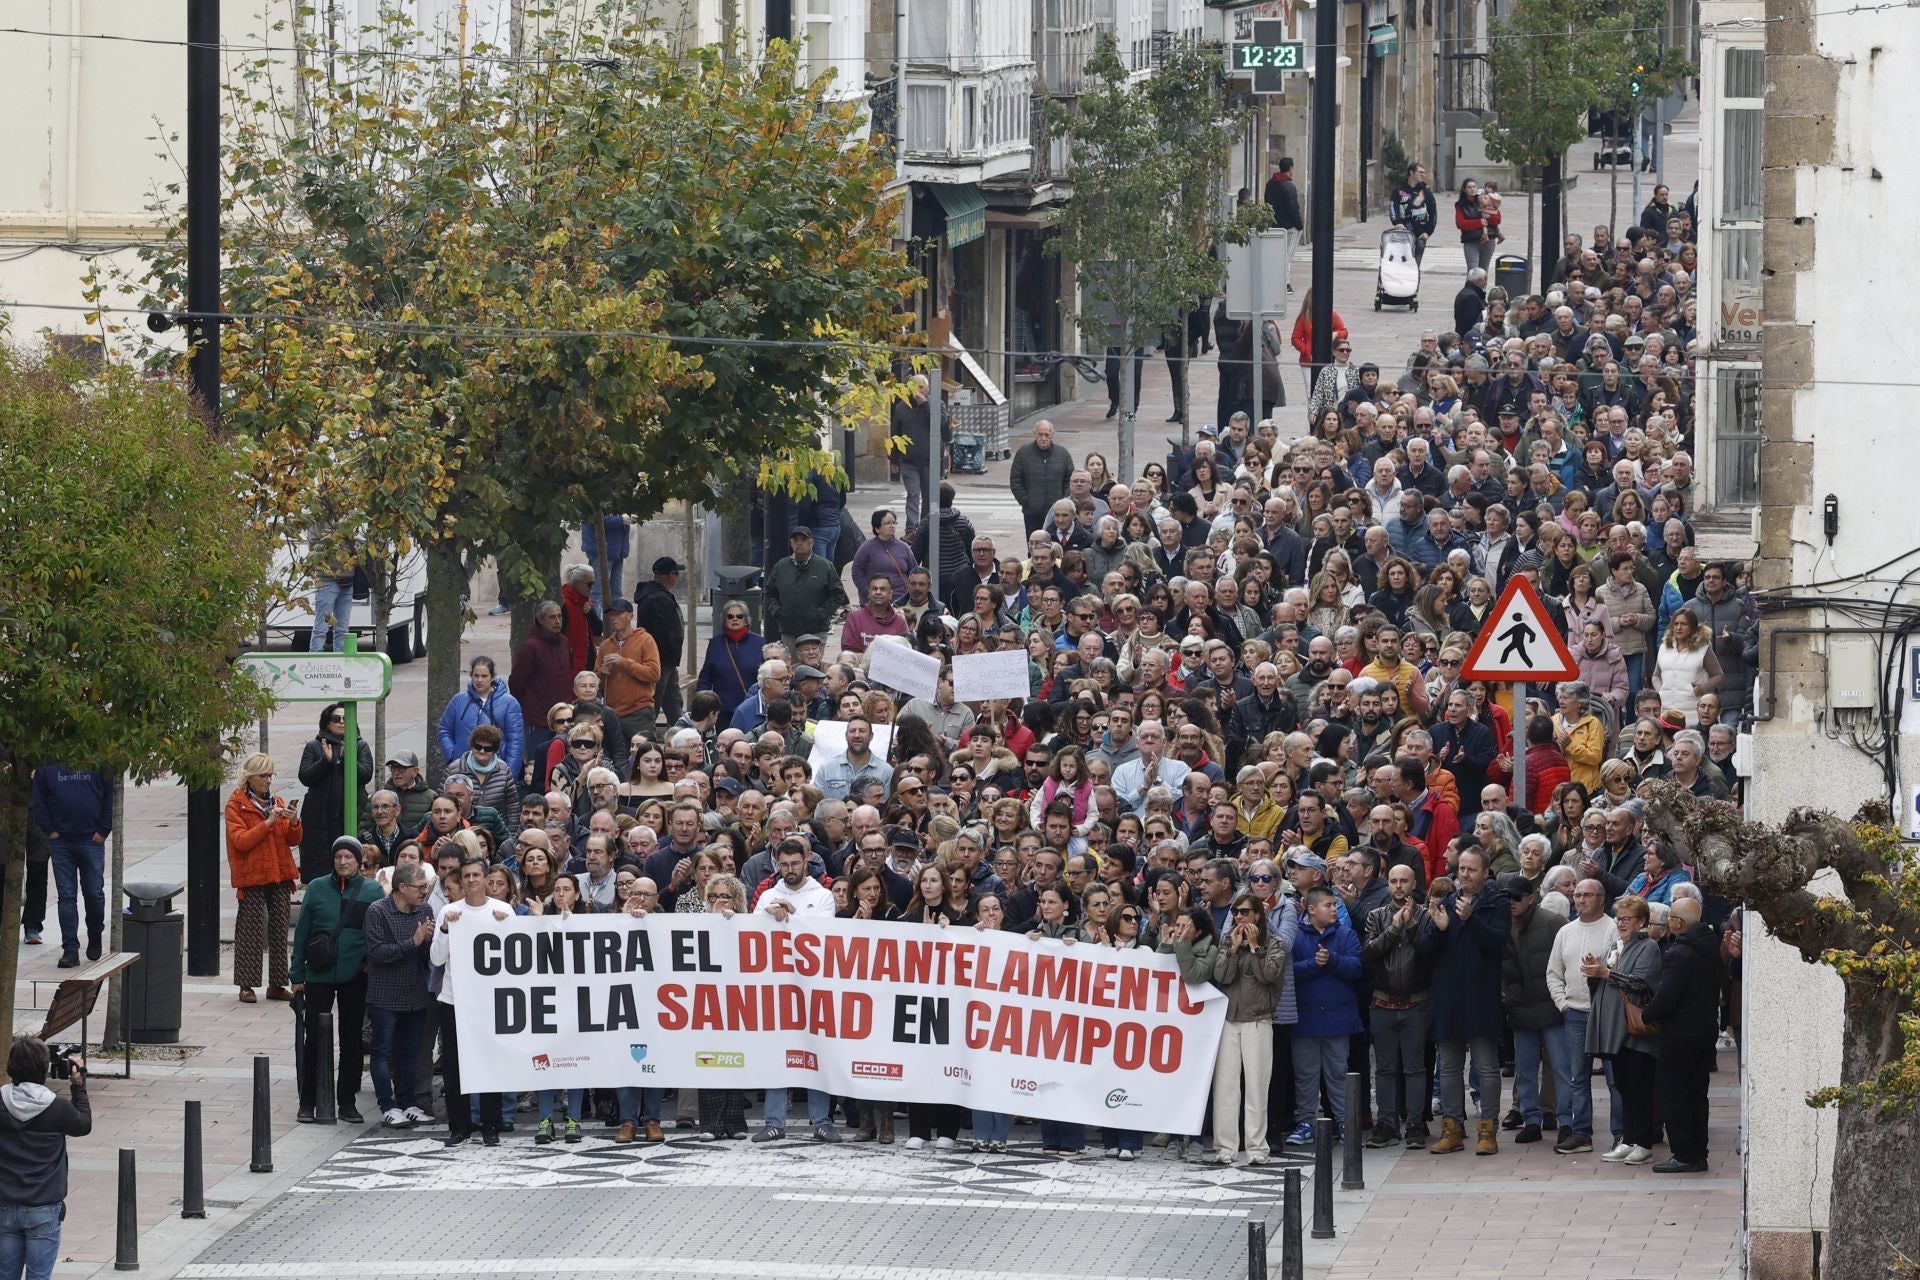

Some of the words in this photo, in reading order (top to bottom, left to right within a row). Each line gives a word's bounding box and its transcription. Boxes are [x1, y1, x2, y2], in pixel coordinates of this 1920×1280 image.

[1241, 45, 1296, 67] 12:23
[1721, 302, 1764, 327] Ve
[473, 930, 655, 976] CONTRA
[671, 930, 722, 973] EL
[494, 987, 558, 1035] DE
[577, 983, 640, 1033] LA
[657, 983, 873, 1040] SANIDAD
[892, 994, 950, 1045] EN
[966, 1000, 1183, 1073] CAMPOO
[717, 1054, 743, 1065] PRC
[787, 1057, 804, 1065] PSOE
[642, 1064, 656, 1074] REC
[854, 1064, 887, 1074] CCOO
[1011, 1078, 1037, 1091] USO
[1109, 1094, 1129, 1103] CSIF
